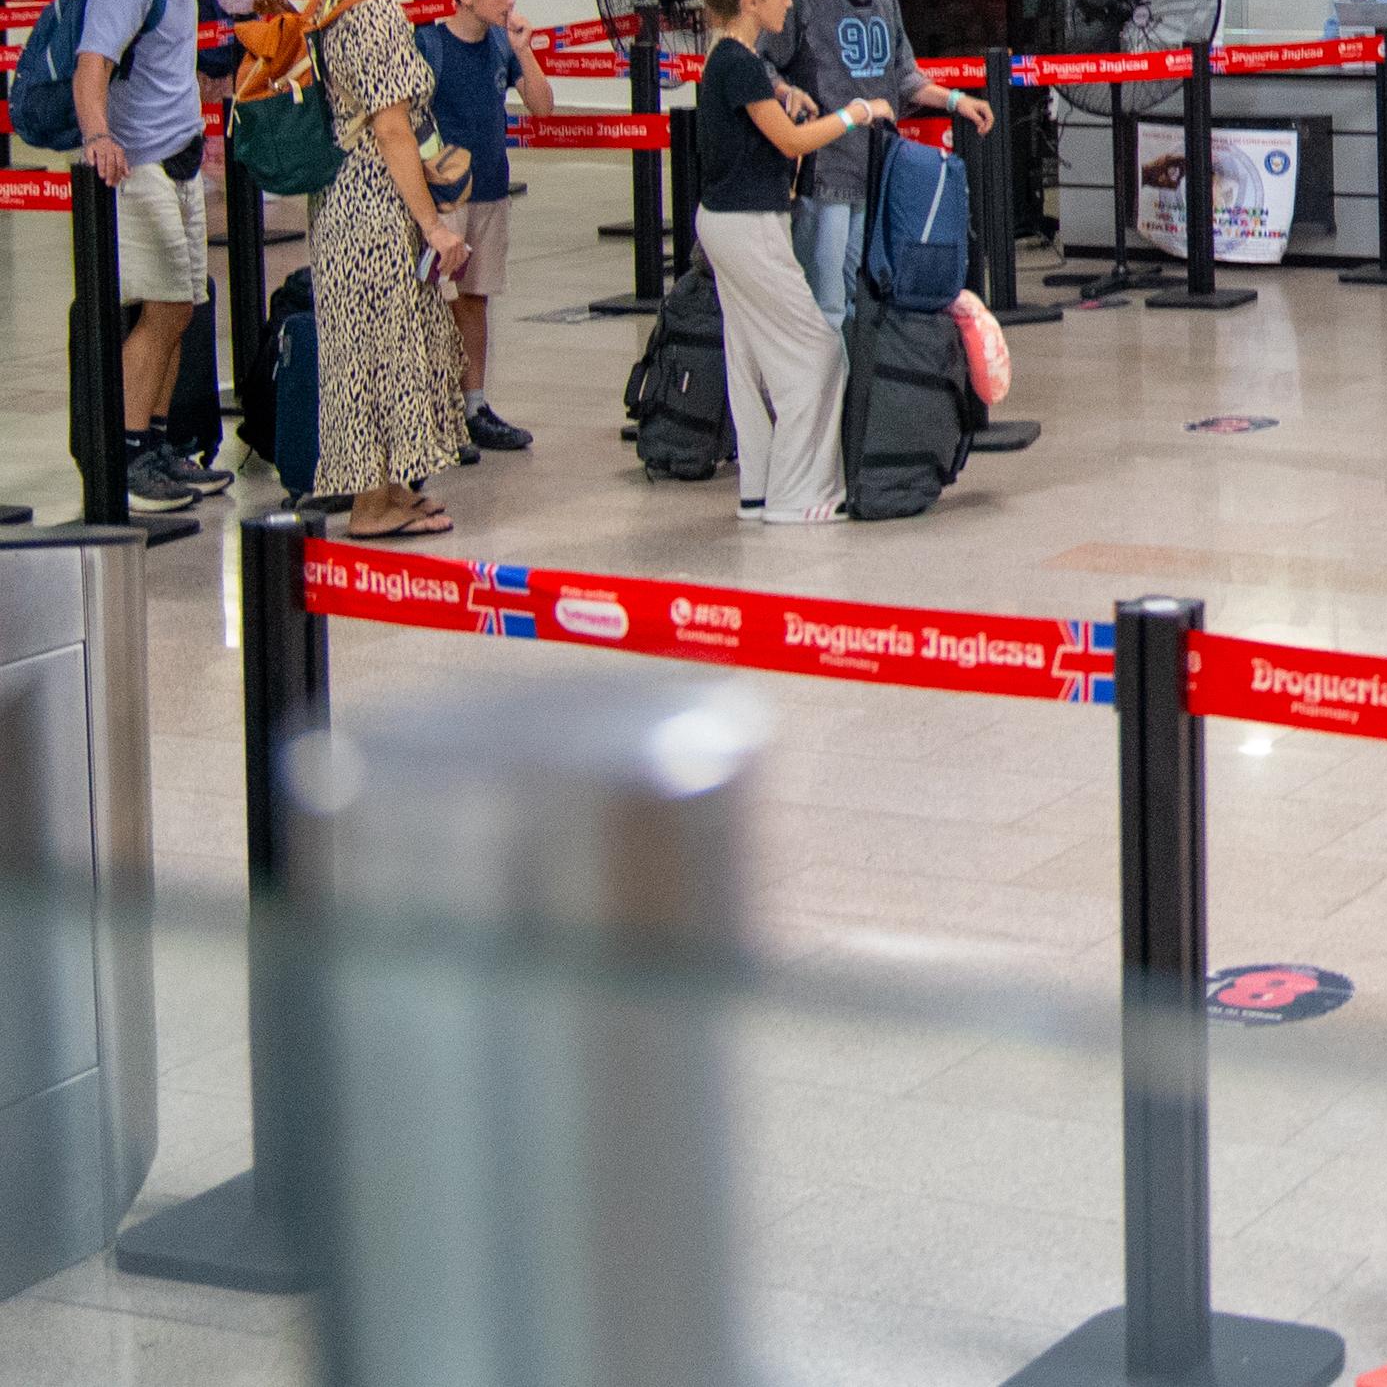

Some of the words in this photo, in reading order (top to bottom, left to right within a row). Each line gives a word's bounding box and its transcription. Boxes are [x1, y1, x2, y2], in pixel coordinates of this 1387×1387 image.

[838, 16, 891, 69] 90
[963, 64, 986, 77] Ingl
[0, 181, 40, 198] guería
[43, 180, 72, 200] Ingl
[355, 561, 461, 604] Inglesa
[783, 611, 914, 658] Droguería
[920, 625, 1046, 669] Inglesa
